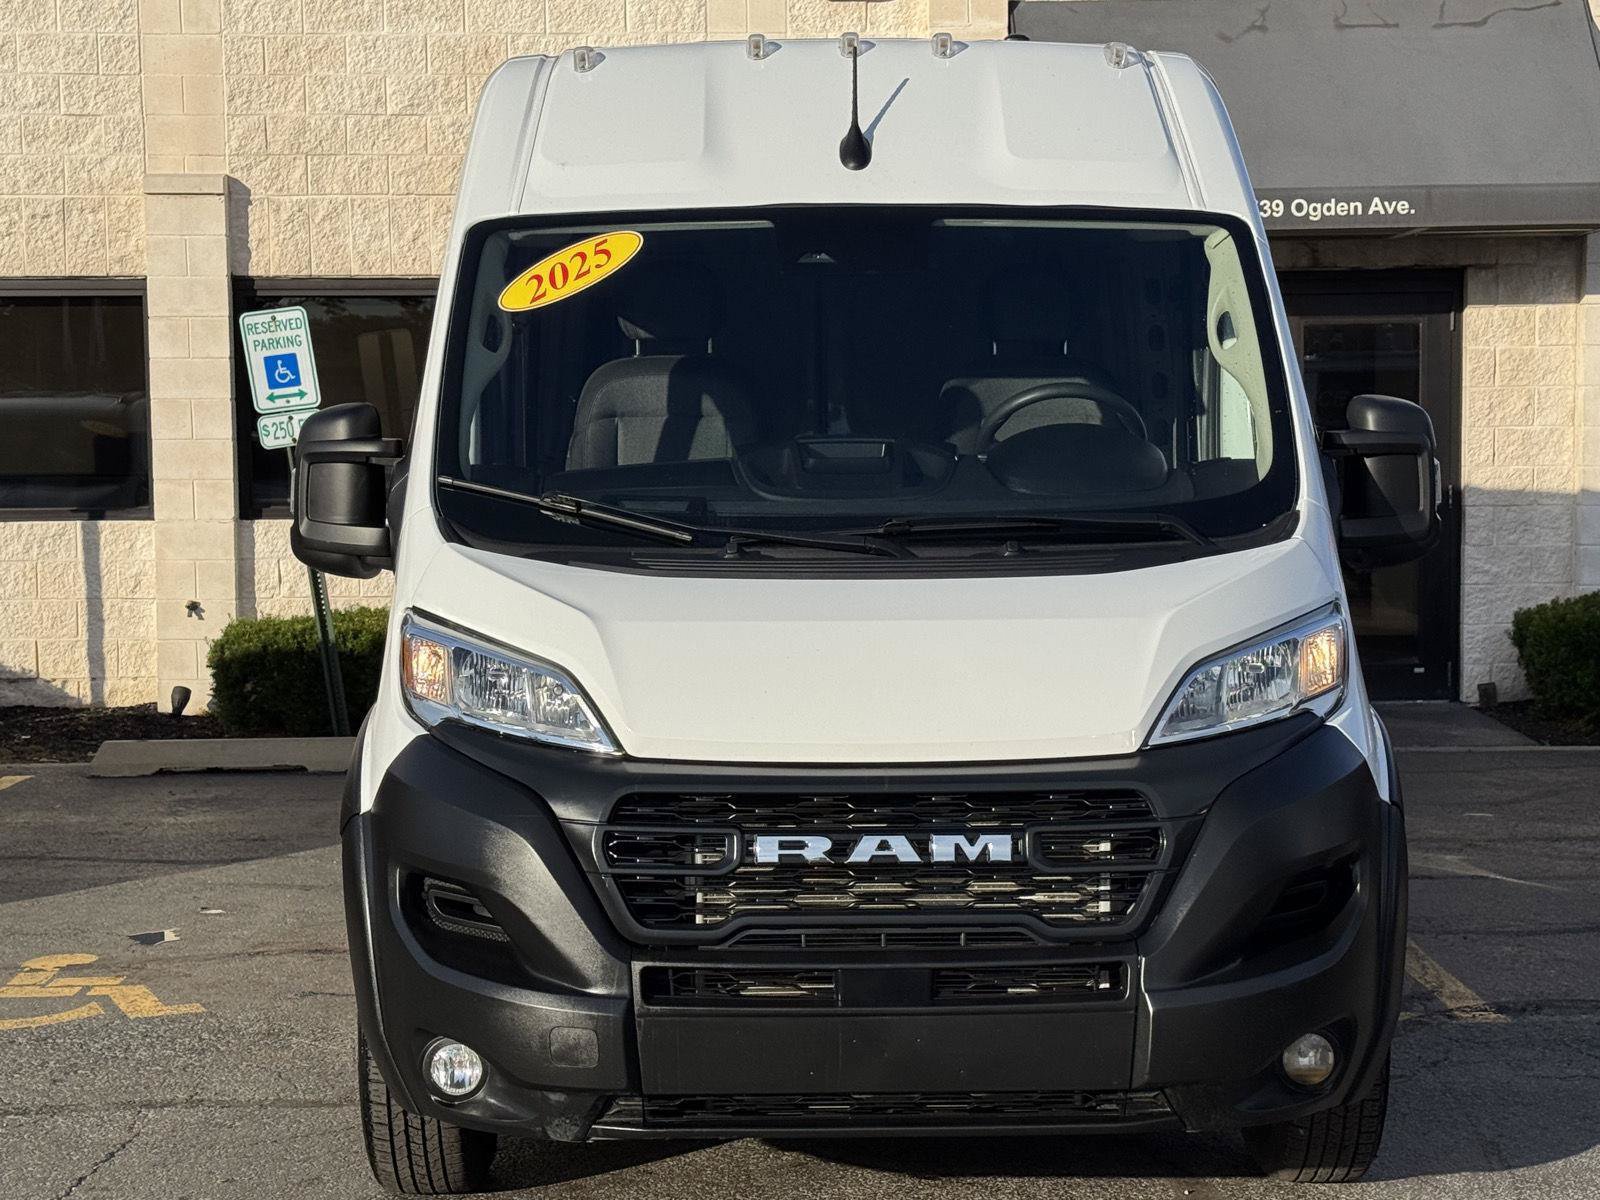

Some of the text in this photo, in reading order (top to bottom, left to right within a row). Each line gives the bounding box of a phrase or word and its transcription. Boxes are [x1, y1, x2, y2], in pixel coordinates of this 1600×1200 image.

[1256, 196, 1416, 221] 39 Ogden Ave.
[525, 238, 612, 304] 2025
[246, 316, 303, 336] RESERVED
[253, 334, 303, 352] PARKING
[262, 419, 295, 440] $250
[754, 834, 1012, 864] RAM
